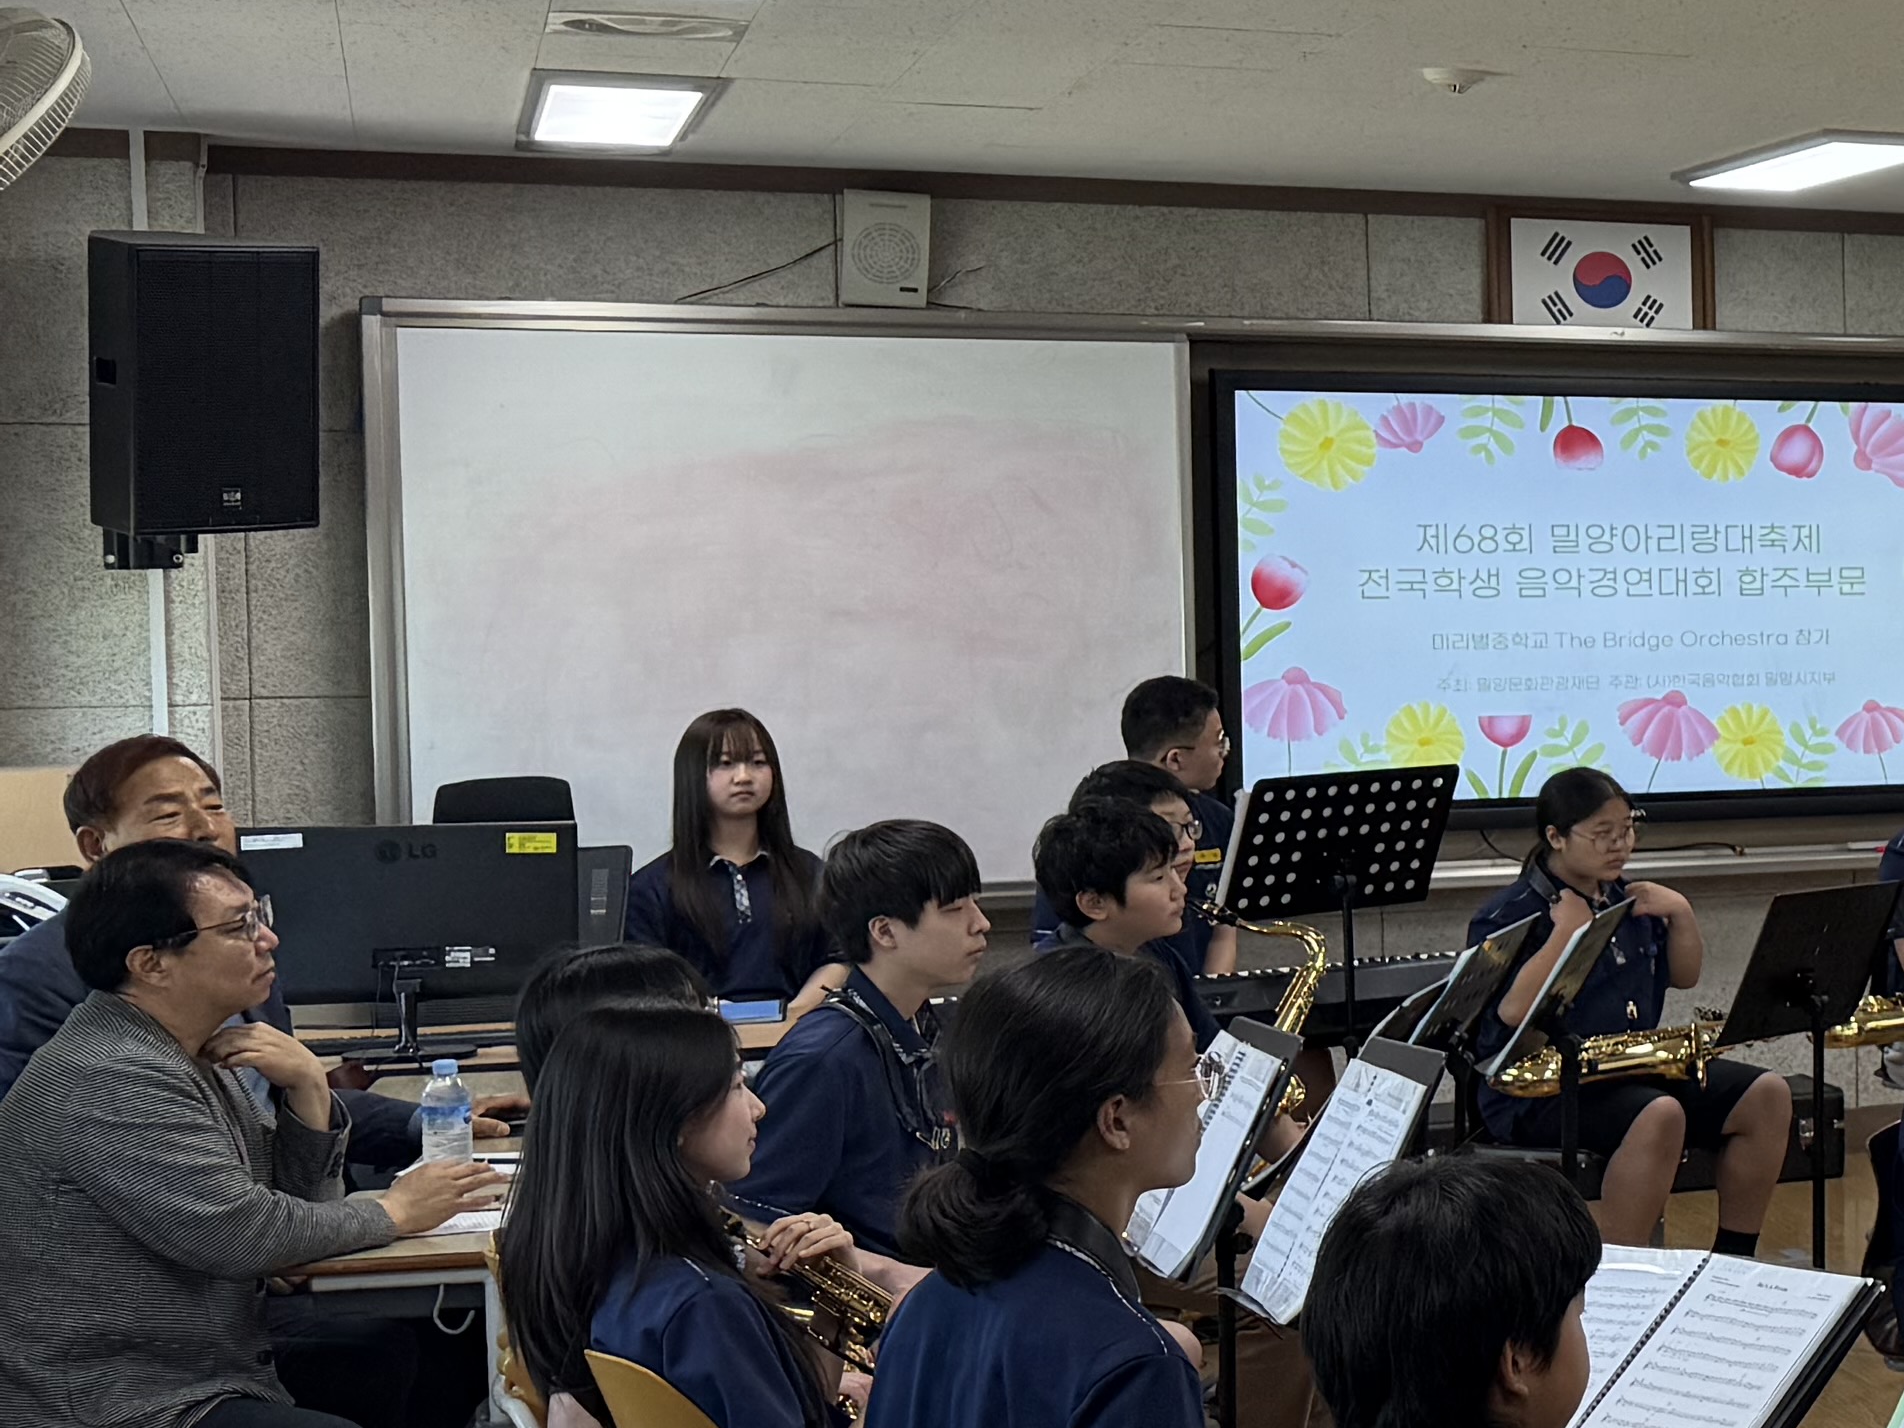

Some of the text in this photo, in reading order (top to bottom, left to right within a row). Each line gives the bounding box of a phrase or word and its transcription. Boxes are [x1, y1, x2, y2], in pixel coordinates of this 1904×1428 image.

[1415, 521, 1823, 556] 제68회 밀양아리랑대축제
[1357, 564, 1867, 601] 전국학생 음악경연대회 합주부문
[1554, 631, 1596, 650] The
[1602, 630, 1674, 652] Bridge
[1680, 629, 1788, 648] Orchestra
[406, 844, 438, 860] LG
